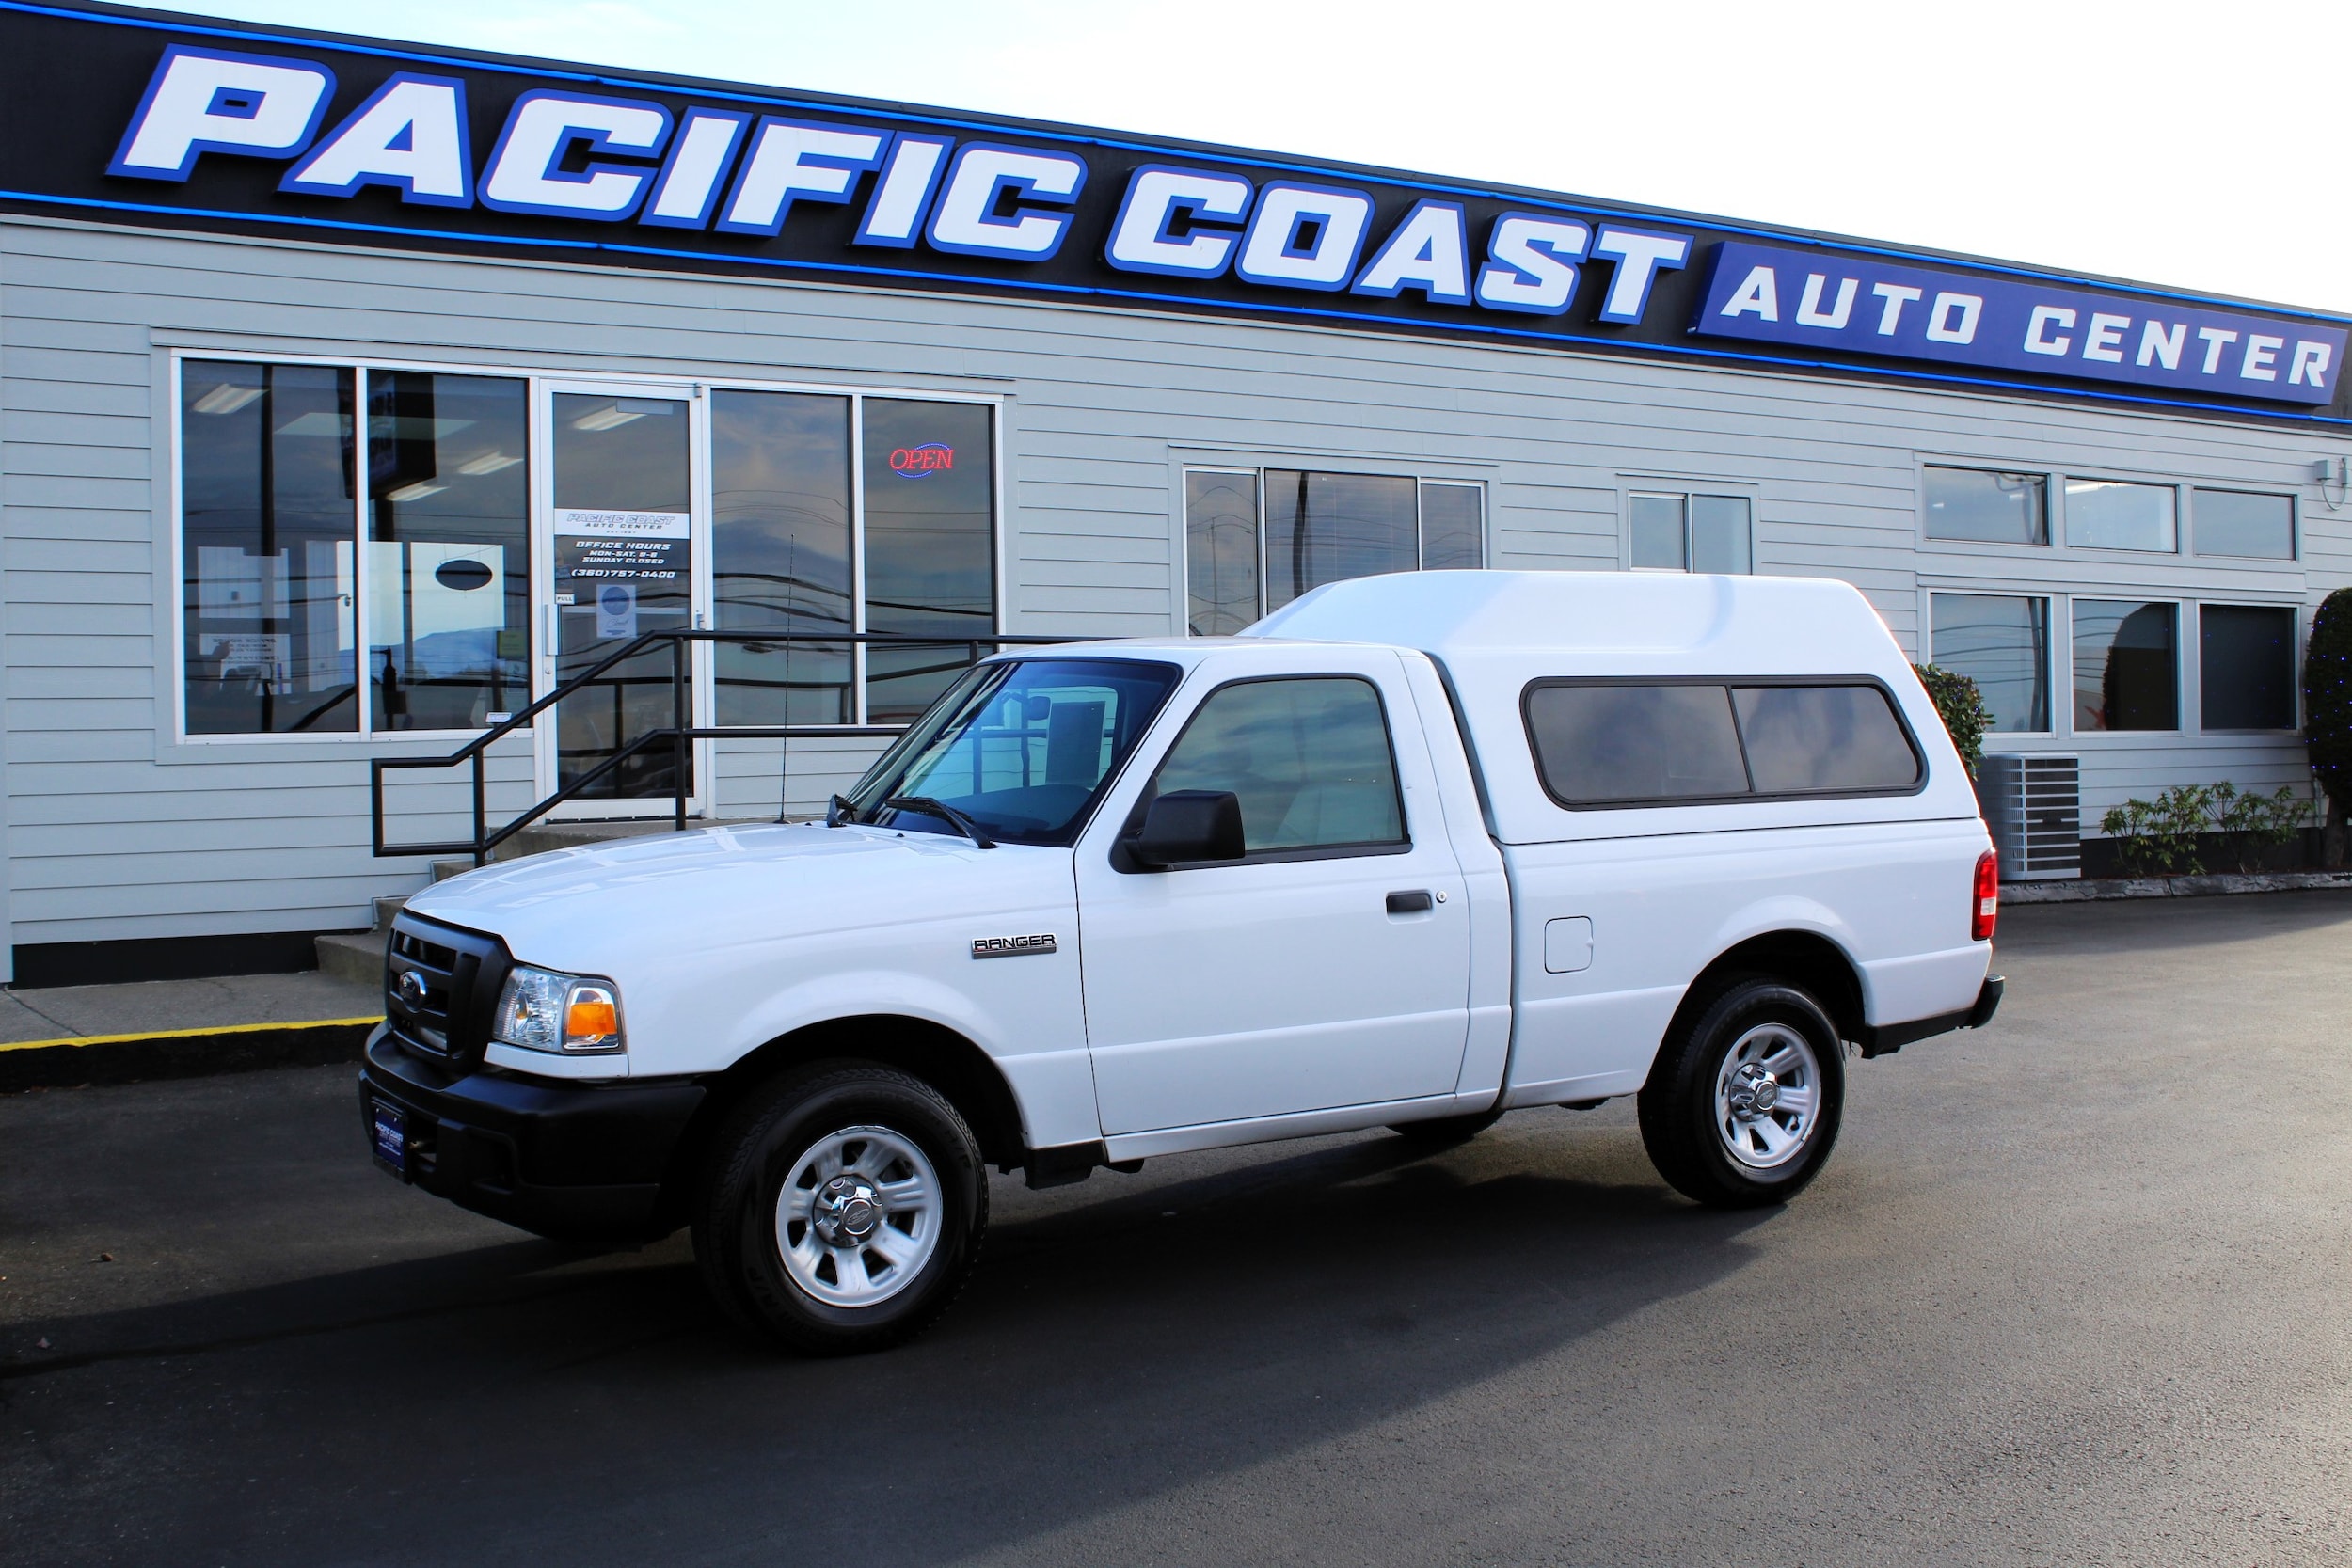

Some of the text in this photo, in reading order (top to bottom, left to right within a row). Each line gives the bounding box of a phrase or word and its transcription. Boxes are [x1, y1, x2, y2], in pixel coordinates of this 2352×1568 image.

[107, 45, 1694, 325] PACIFIC COAST
[1721, 266, 2332, 388] AUTO CENTER
[889, 448, 954, 469] OPEN
[567, 513, 675, 525] PACIFIC COAST
[575, 541, 671, 551] OFFICE HOURS
[571, 569, 675, 578] (360)757-0400
[974, 934, 1056, 950] RANGER
